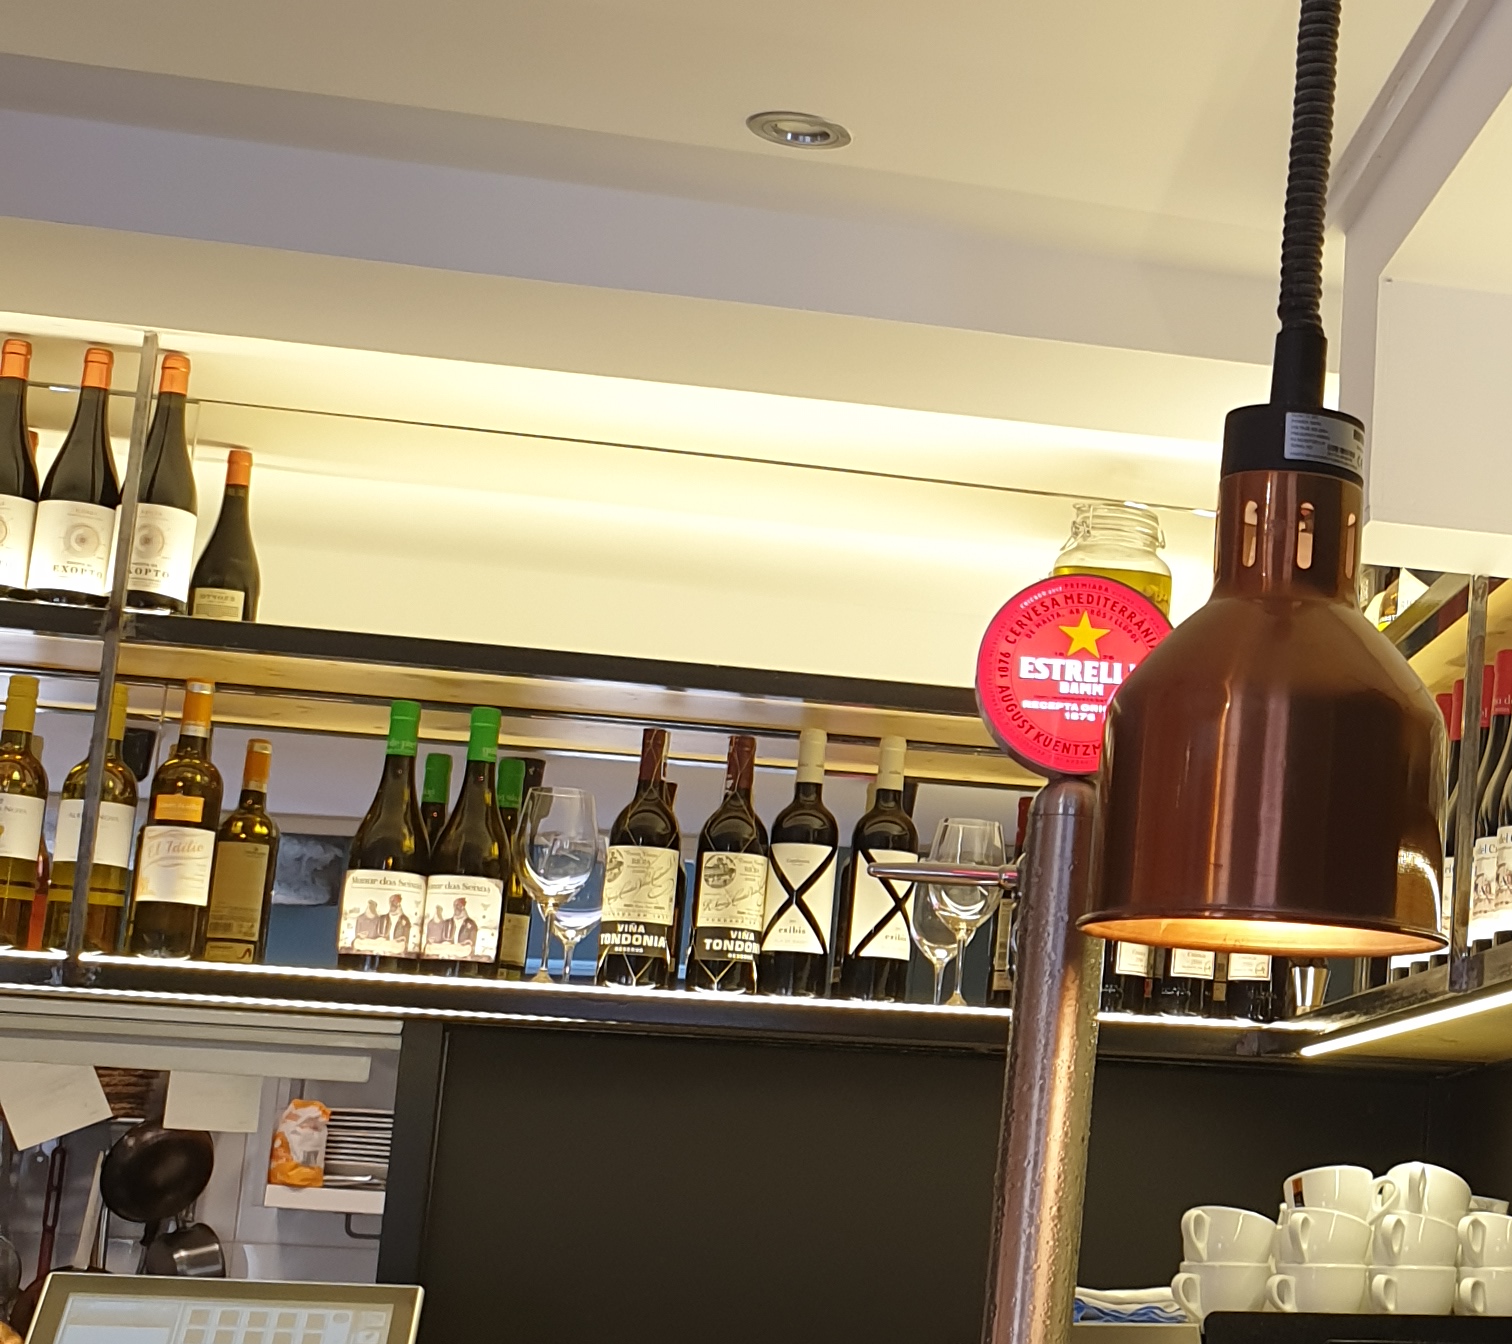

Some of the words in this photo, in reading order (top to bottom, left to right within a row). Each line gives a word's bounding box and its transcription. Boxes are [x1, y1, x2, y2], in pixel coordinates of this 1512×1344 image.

[1004, 597, 1060, 644] CERVESA
[1019, 656, 1137, 685] ESTRELL
[1058, 681, 1105, 696] DAMM
[1021, 699, 1079, 712] RECEPTA
[997, 685, 1036, 736] AUGUST
[1033, 730, 1101, 756] KUENTZM
[617, 922, 645, 934] VIÑA
[730, 929, 755, 941] VIÑA
[600, 932, 667, 949] TONDONIA
[704, 938, 761, 955] TONDON
